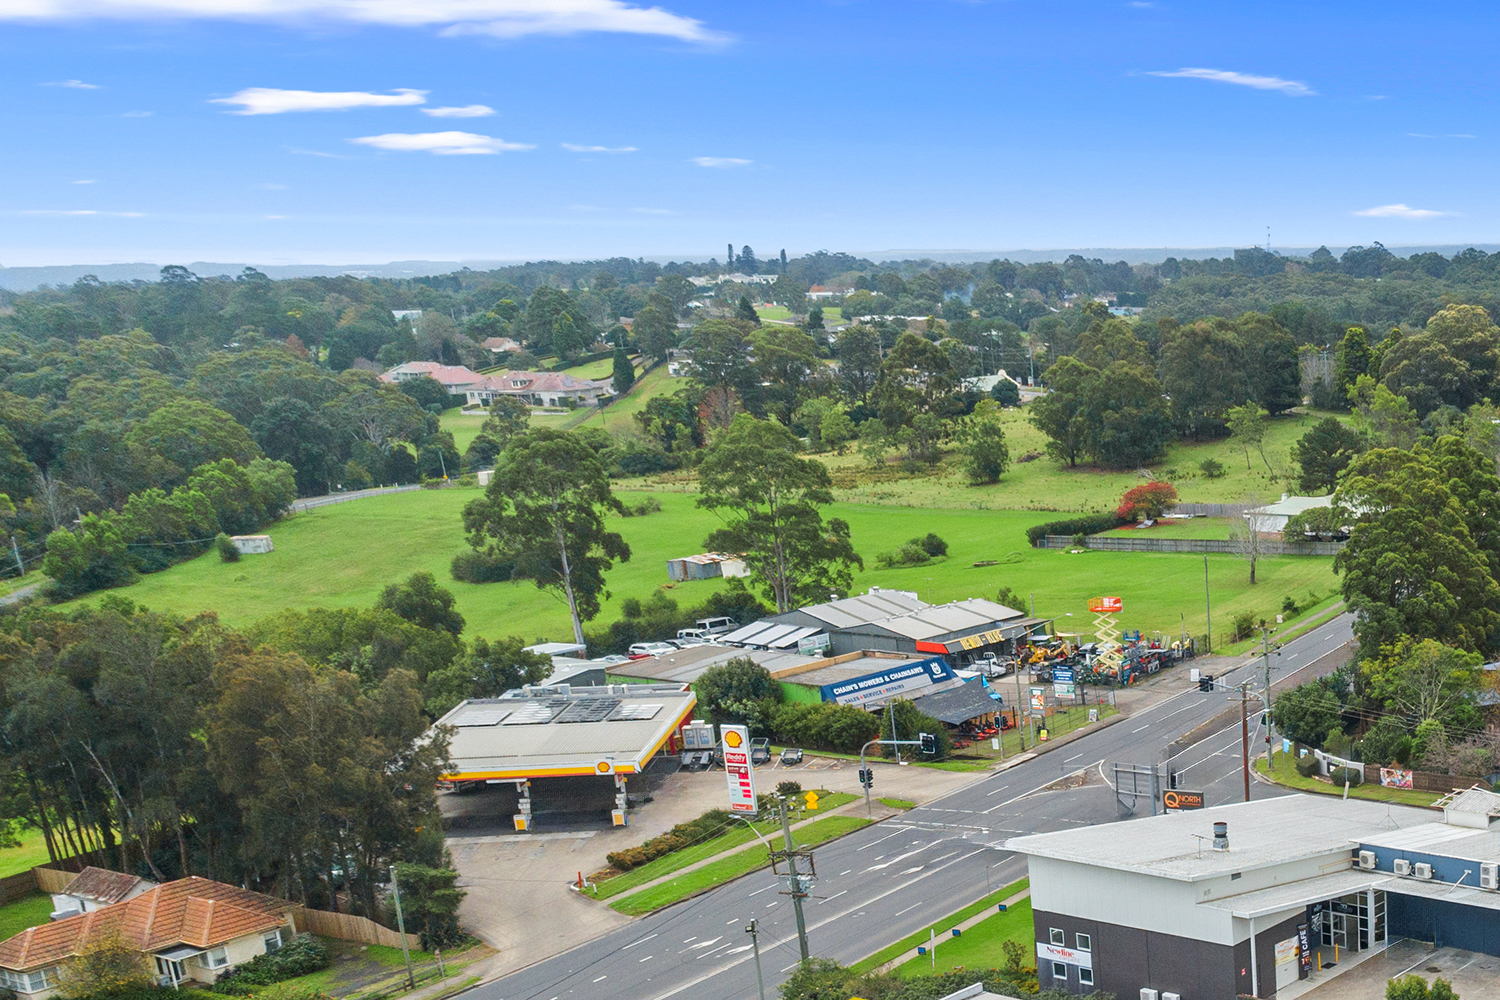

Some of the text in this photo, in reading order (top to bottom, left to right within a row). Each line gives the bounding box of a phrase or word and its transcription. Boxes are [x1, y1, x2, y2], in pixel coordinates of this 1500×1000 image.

[833, 683, 859, 695] CHAIN'S
[858, 676, 884, 688] MOWERS
[890, 666, 924, 680] CHAINSAWS
[863, 690, 883, 699] SERVICE
[885, 684, 905, 693] REPAIRS
[726, 754, 745, 762] Reddy
[1300, 930, 1308, 950] CAFE
